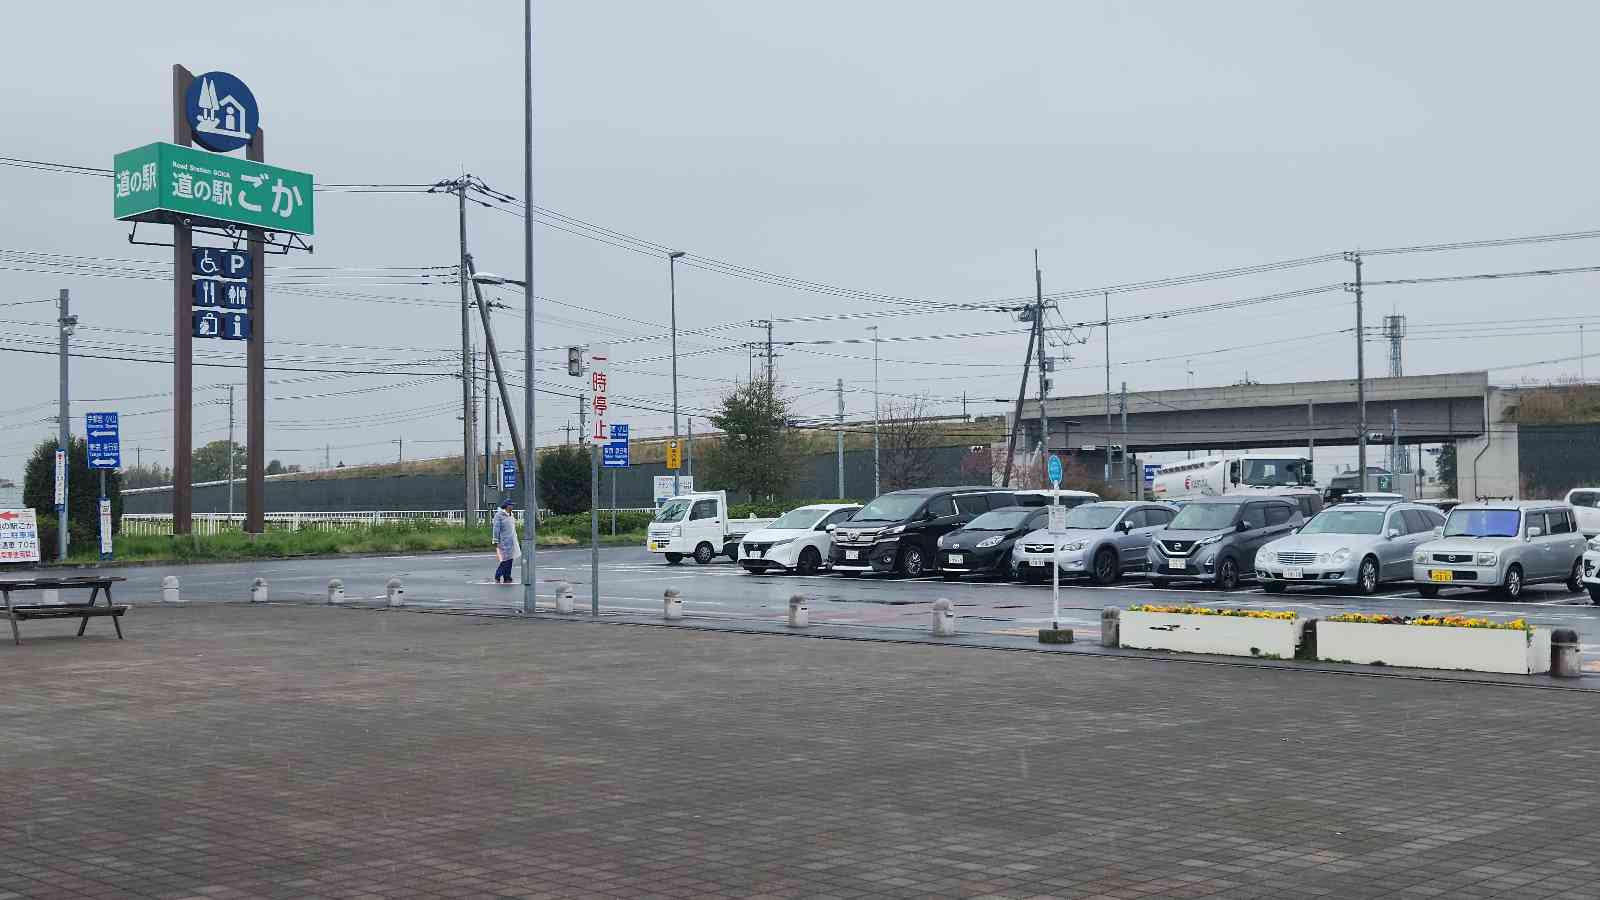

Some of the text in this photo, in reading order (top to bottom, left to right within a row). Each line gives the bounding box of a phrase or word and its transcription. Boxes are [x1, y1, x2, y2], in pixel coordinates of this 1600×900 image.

[172, 160, 188, 169] Road
[116, 162, 158, 198] 道の駅
[172, 172, 303, 218] 道の駅 ごか
[231, 255, 244, 273] P
[592, 355, 608, 440] 一時停止
[0, 521, 34, 530] の駅ごか
